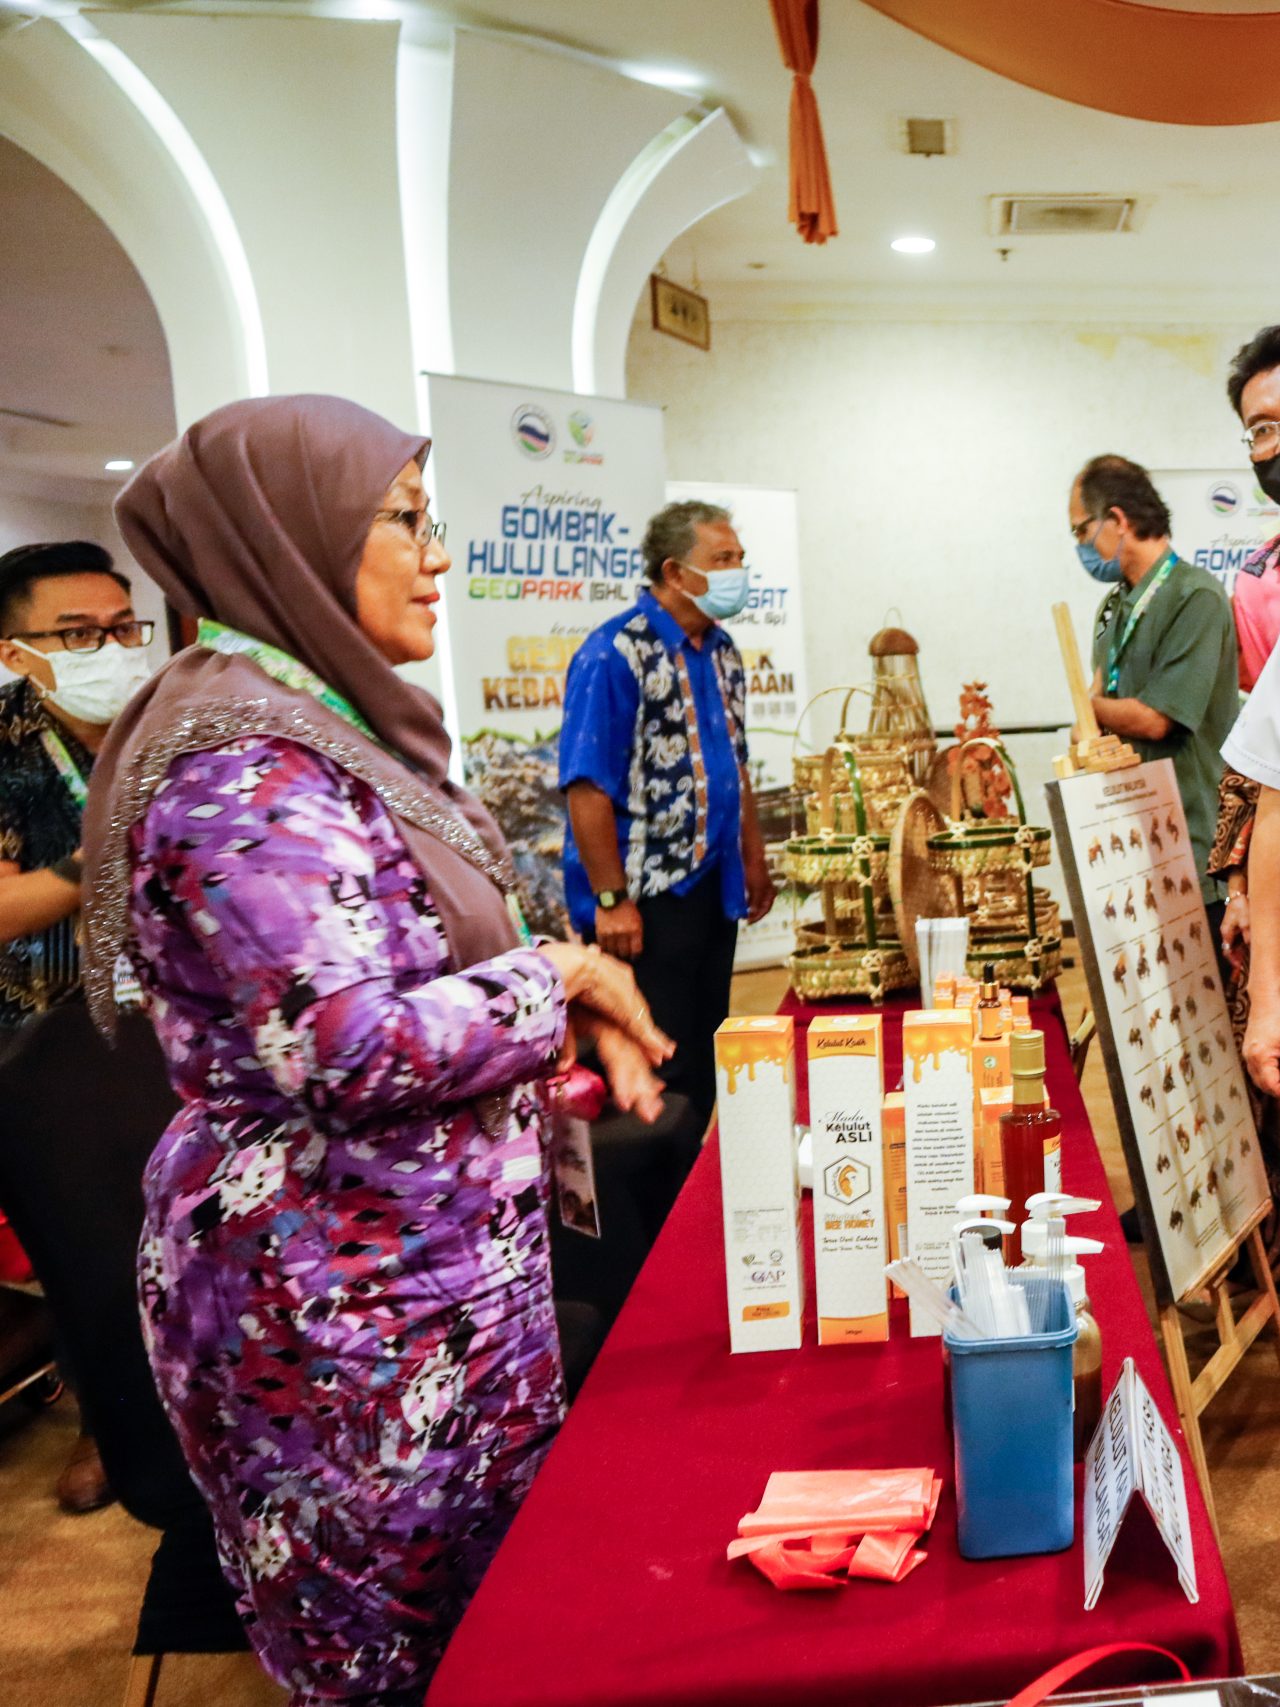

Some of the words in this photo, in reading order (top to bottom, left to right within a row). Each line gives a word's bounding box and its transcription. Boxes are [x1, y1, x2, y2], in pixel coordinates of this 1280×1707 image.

[520, 484, 602, 509] Aspiring
[467, 540, 545, 576] HULU
[554, 545, 646, 579] LANGA
[468, 578, 585, 601] GEOPARK
[745, 587, 789, 610] GAT
[826, 1121, 871, 1132] Kelulut
[836, 1131, 872, 1144] ASLI
[844, 1218, 875, 1229] HONEY
[1095, 1471, 1111, 1557] LANGAT
